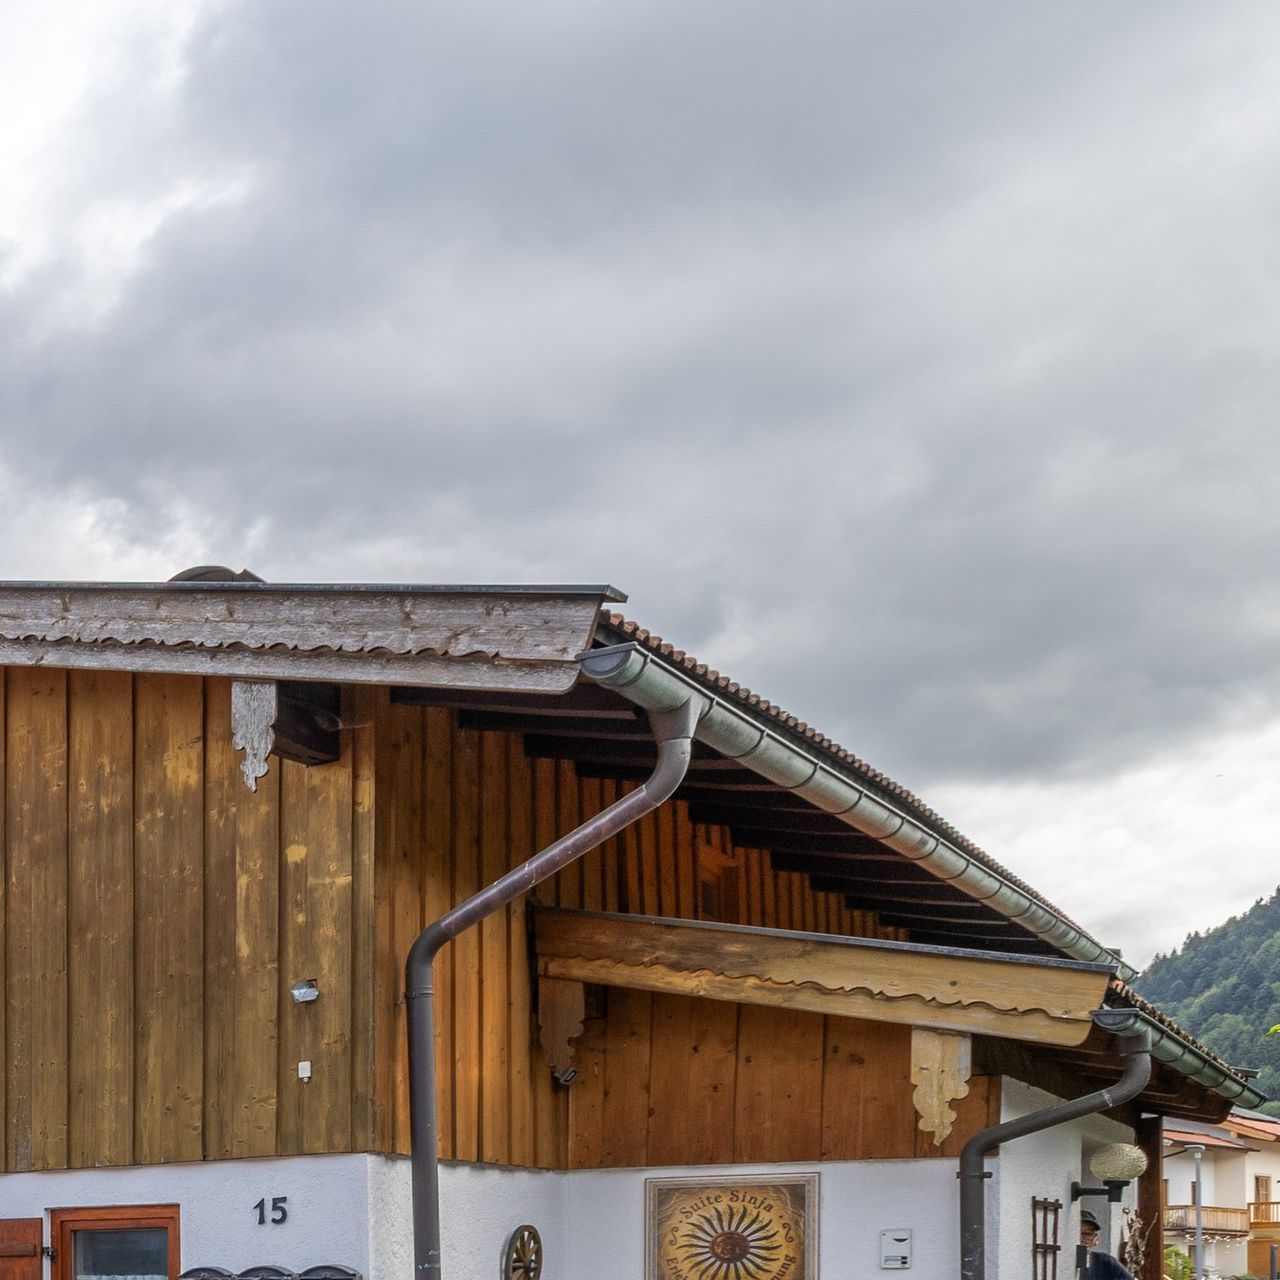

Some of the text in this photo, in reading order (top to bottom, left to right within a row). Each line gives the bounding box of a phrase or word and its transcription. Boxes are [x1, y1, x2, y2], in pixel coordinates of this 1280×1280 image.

[253, 1196, 288, 1226] 15
[679, 1190, 774, 1220] Suite Sinja
